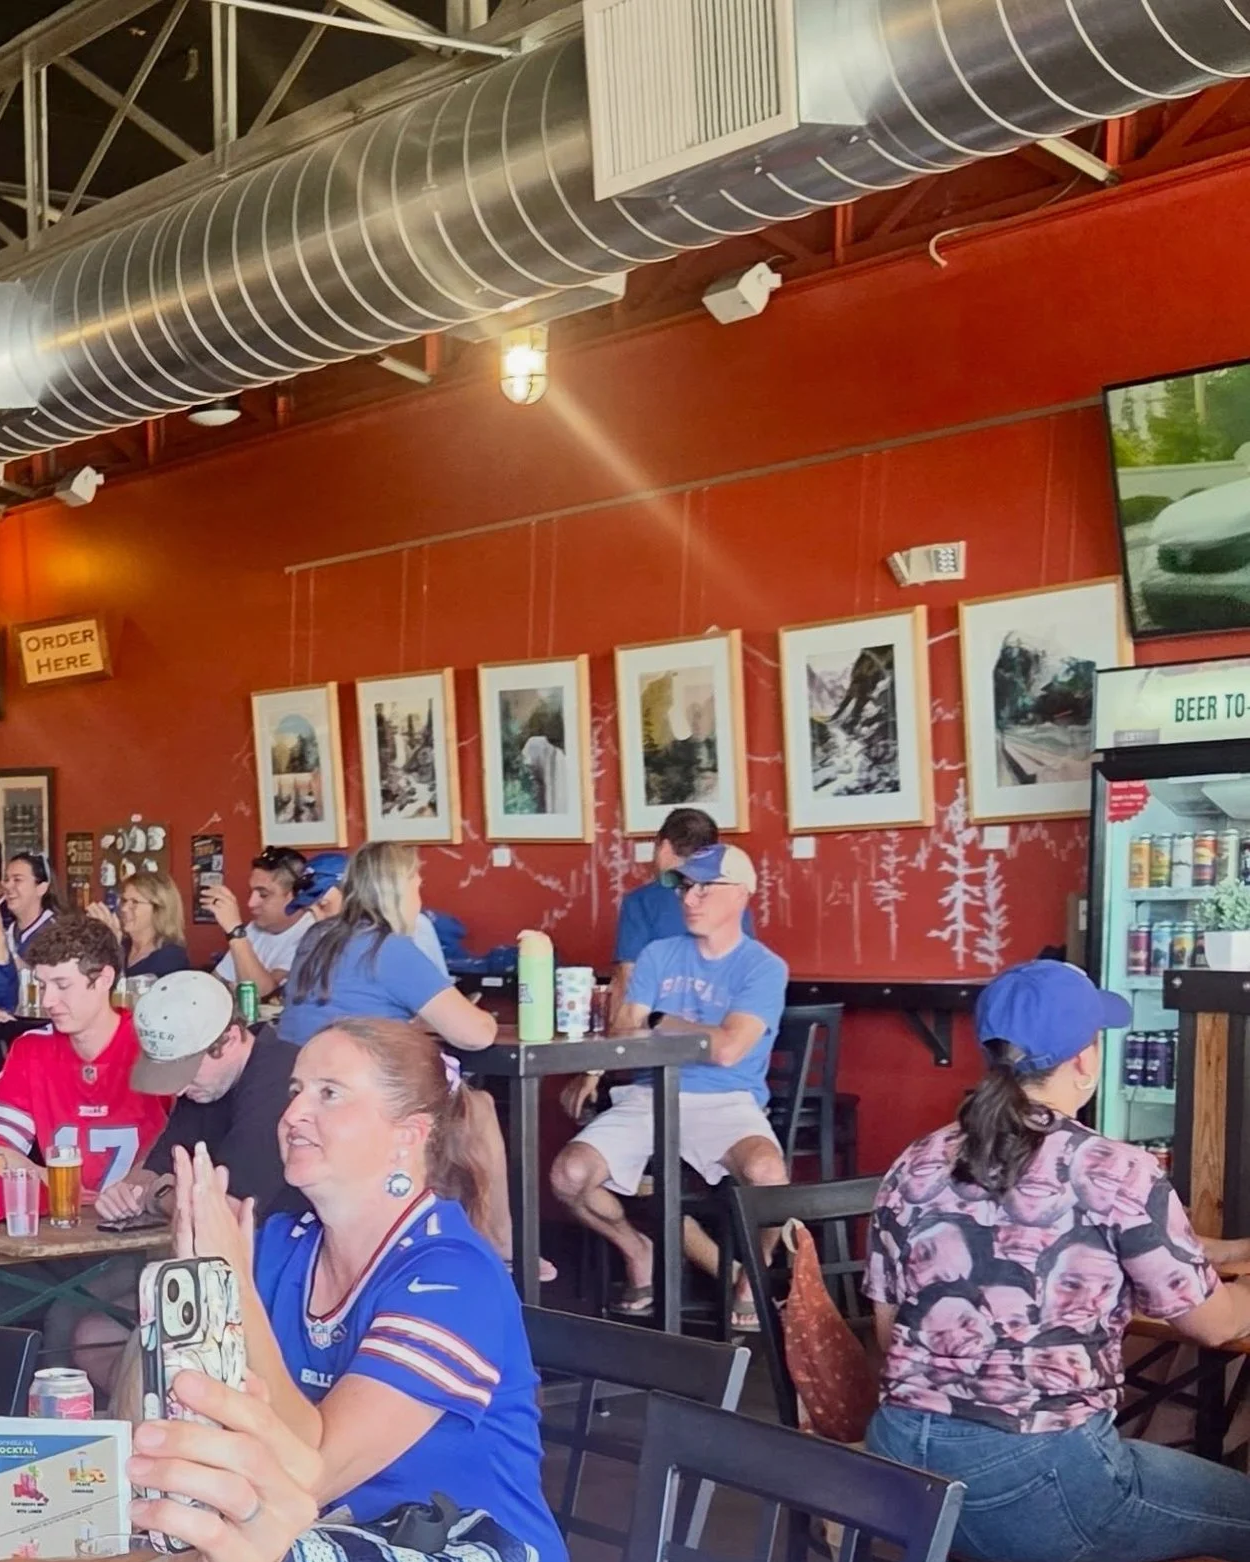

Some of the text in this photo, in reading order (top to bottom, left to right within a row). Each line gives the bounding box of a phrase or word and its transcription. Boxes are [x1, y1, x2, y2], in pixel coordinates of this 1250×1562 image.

[25, 628, 95, 653] ORDER
[36, 652, 92, 675] HERE
[1175, 695, 1217, 723] BEER
